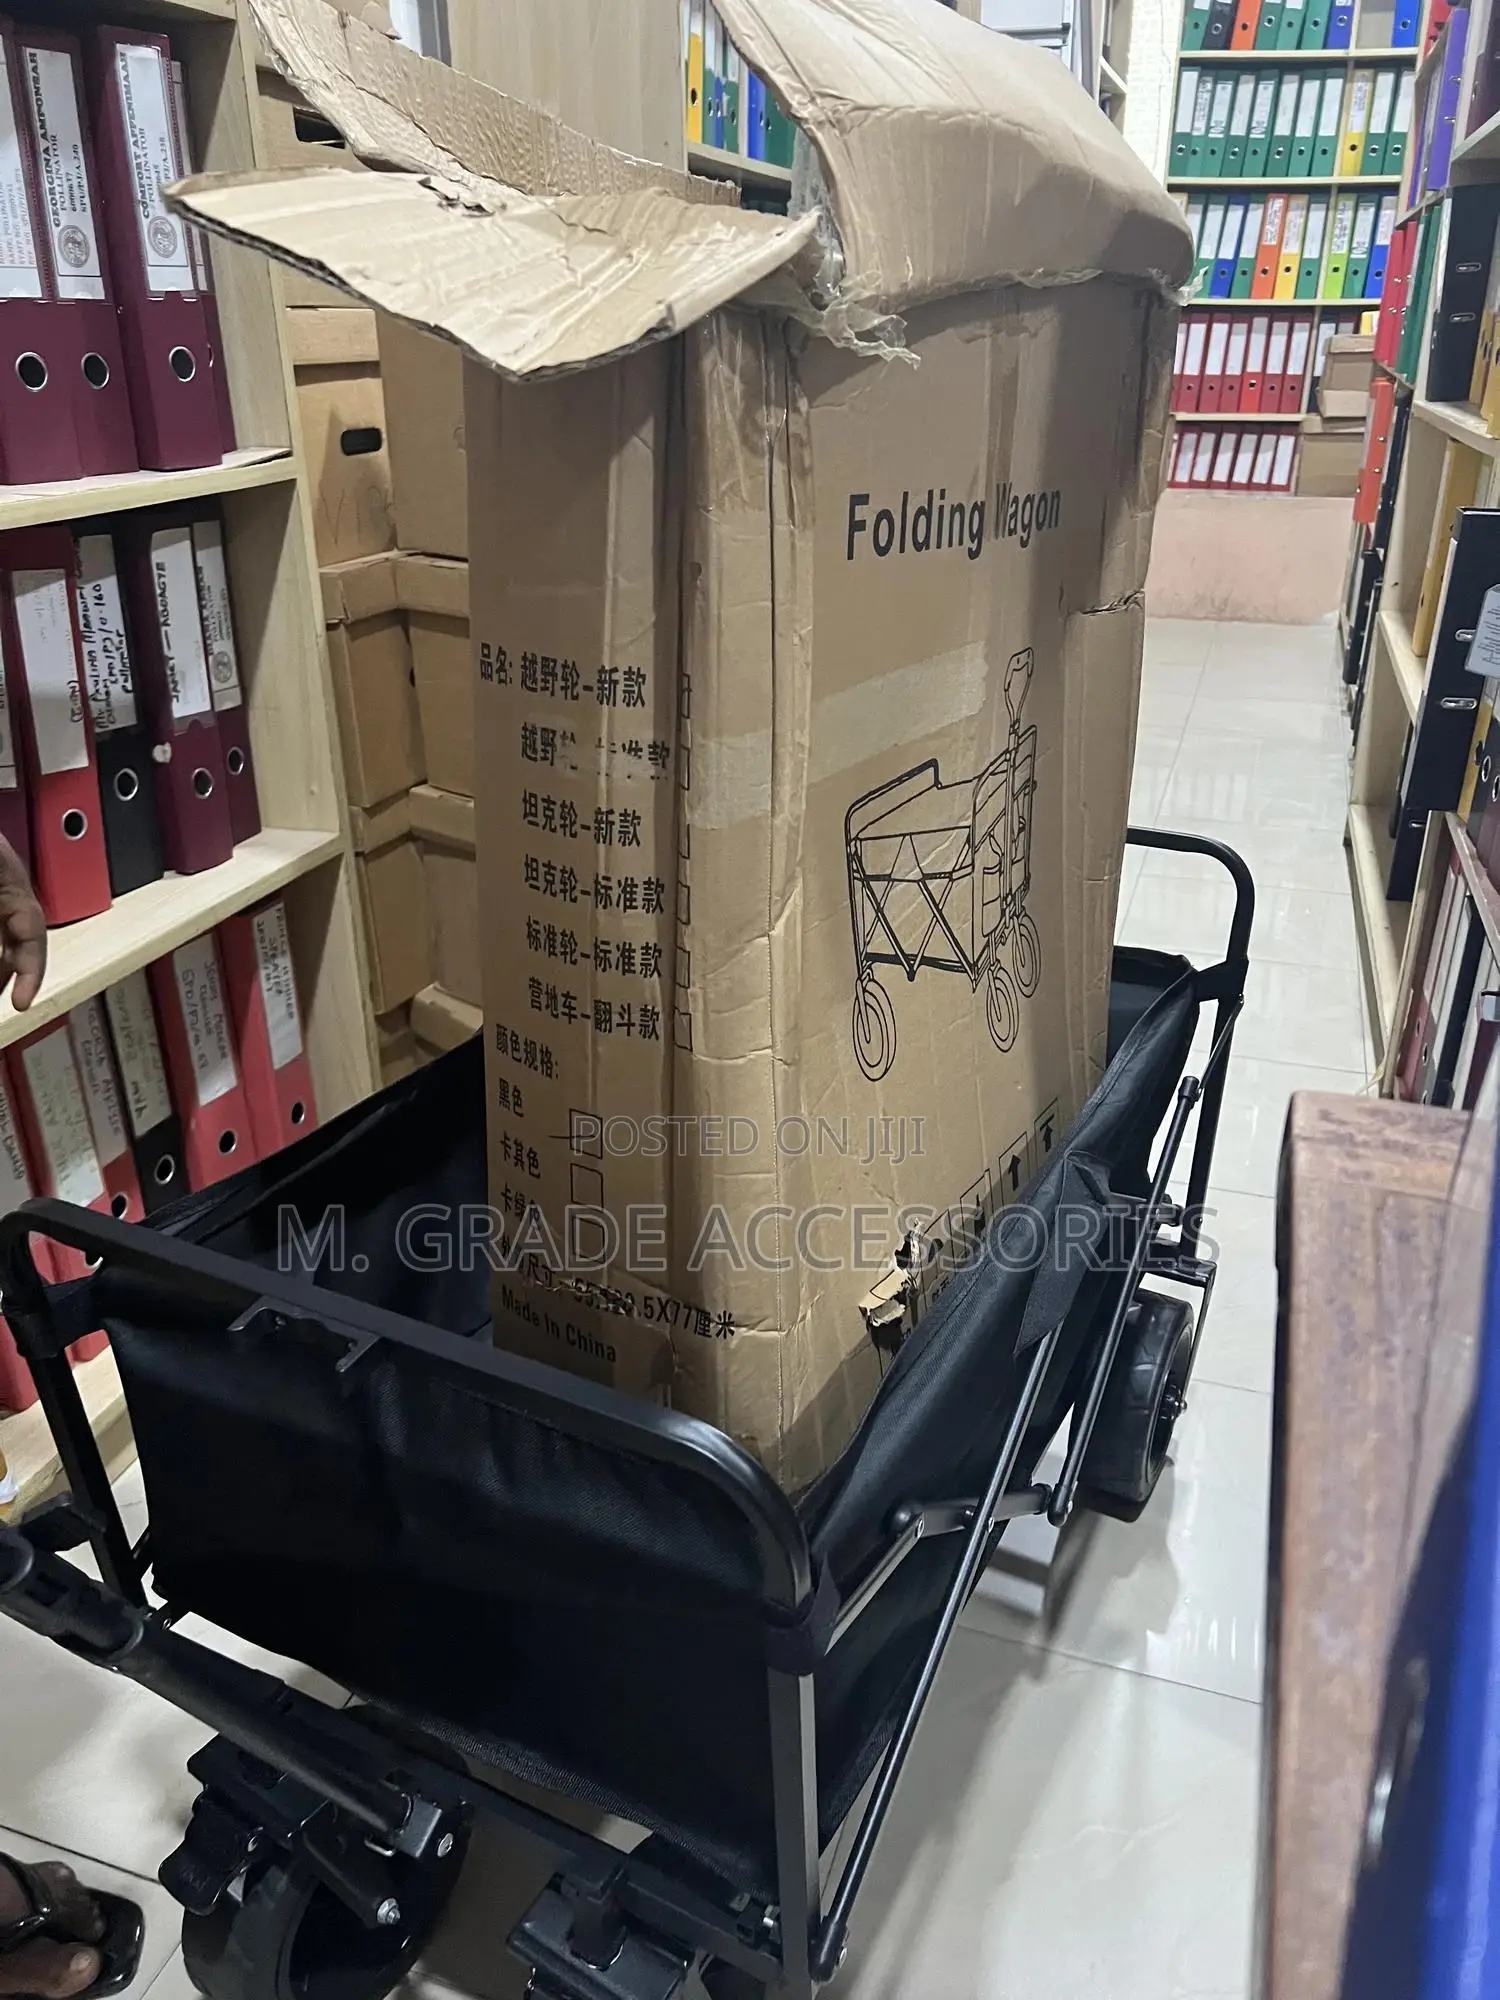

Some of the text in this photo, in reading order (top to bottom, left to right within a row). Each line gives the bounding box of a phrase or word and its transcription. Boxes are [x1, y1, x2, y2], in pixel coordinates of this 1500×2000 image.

[28, 52, 61, 228] GEORGINA AMPONSAH
[50, 134, 67, 212] POLLINATOR
[134, 153, 150, 219] COMFORT
[847, 482, 1062, 561] Folding Wagon
[480, 642, 648, 708] 品名: 越野轮-新款
[522, 788, 642, 848] 坦克轮-新款
[524, 853, 665, 915] 坦克轮-标准款
[526, 915, 663, 979] 标准轮-标准款
[528, 975, 661, 1041] 营地车-翻斗款
[495, 1022, 559, 1080] 颜色规格:
[499, 1077, 525, 1118] 黑色
[499, 1130, 542, 1180] 卡其色
[501, 1284, 541, 1327] Made
[565, 1322, 617, 1364] China
